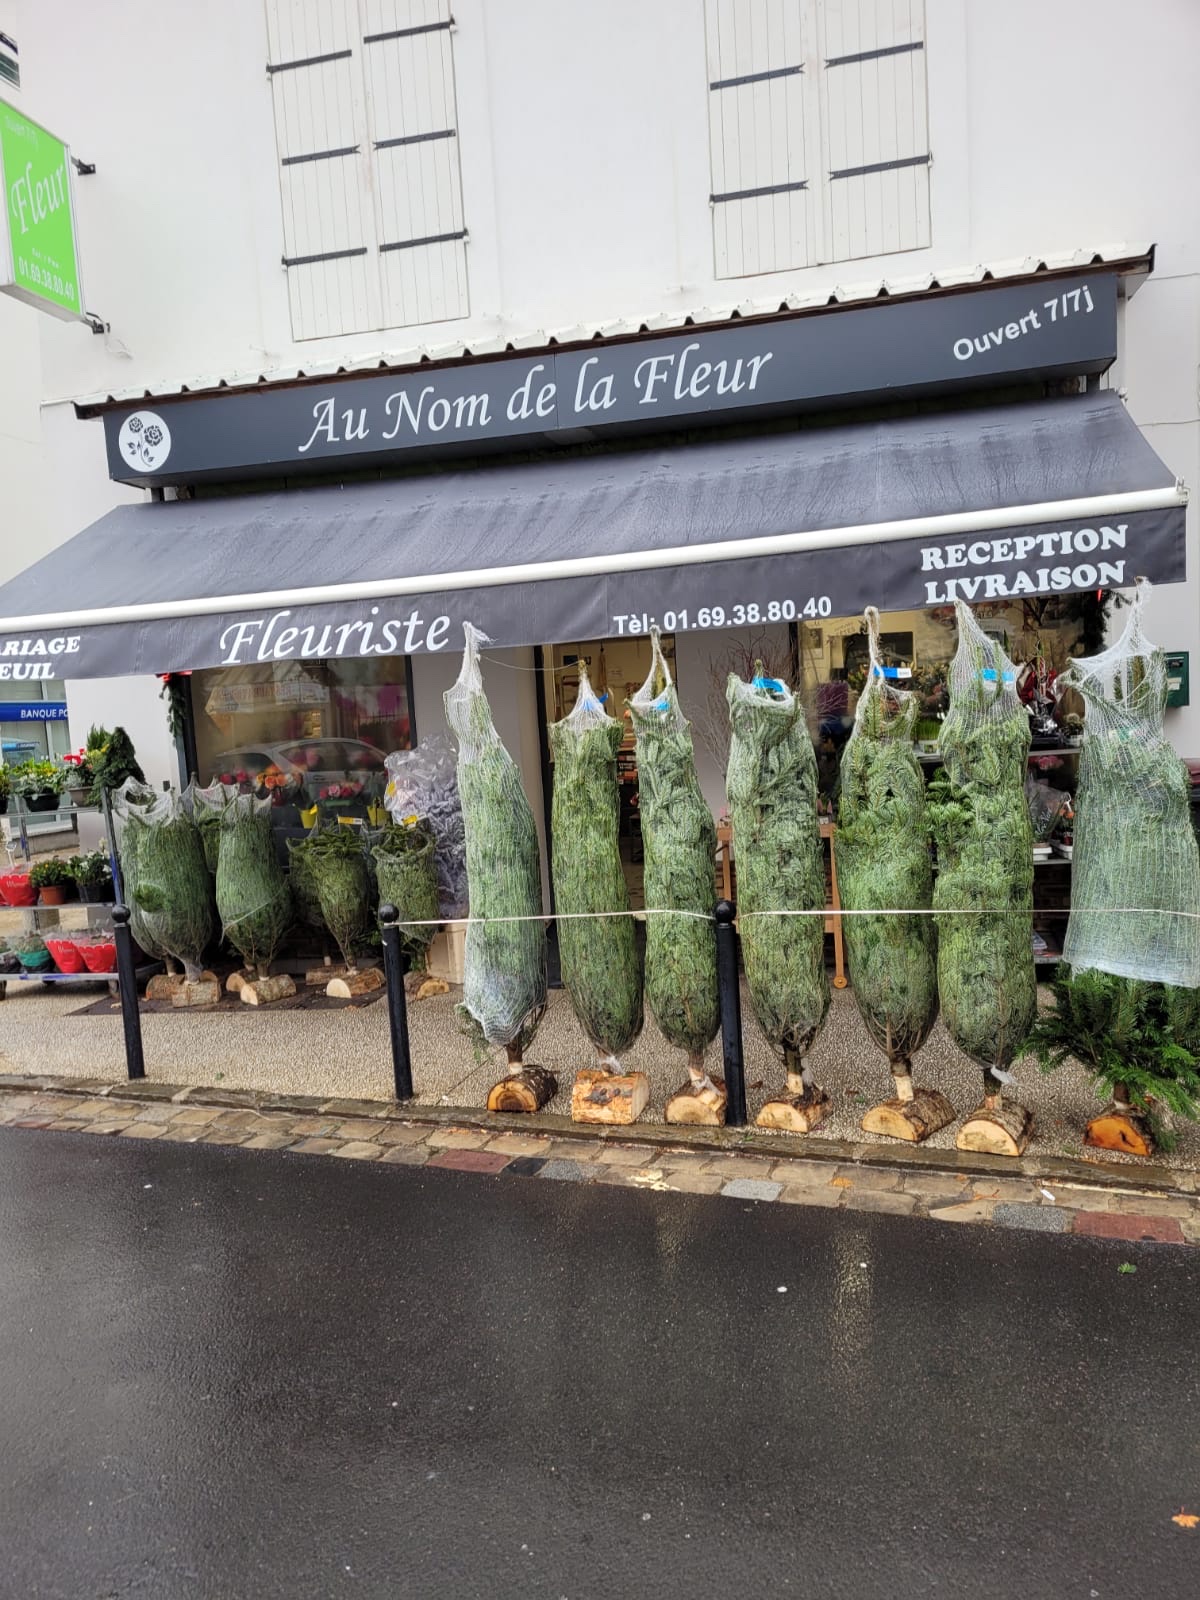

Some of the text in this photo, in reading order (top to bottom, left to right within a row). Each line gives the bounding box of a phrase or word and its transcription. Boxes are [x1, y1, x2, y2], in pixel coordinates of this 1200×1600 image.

[11, 161, 64, 234] Fleur
[953, 285, 1094, 361] Ouvert 7/7j
[298, 343, 773, 452] Au Nom de la Fleur
[920, 524, 1129, 571] RECEPTION
[924, 560, 1126, 604] LIVRAISON
[219, 606, 451, 664] Fleuriste
[663, 596, 832, 630] 01.69.38.80.40
[20, 708, 57, 719] BANQUE
